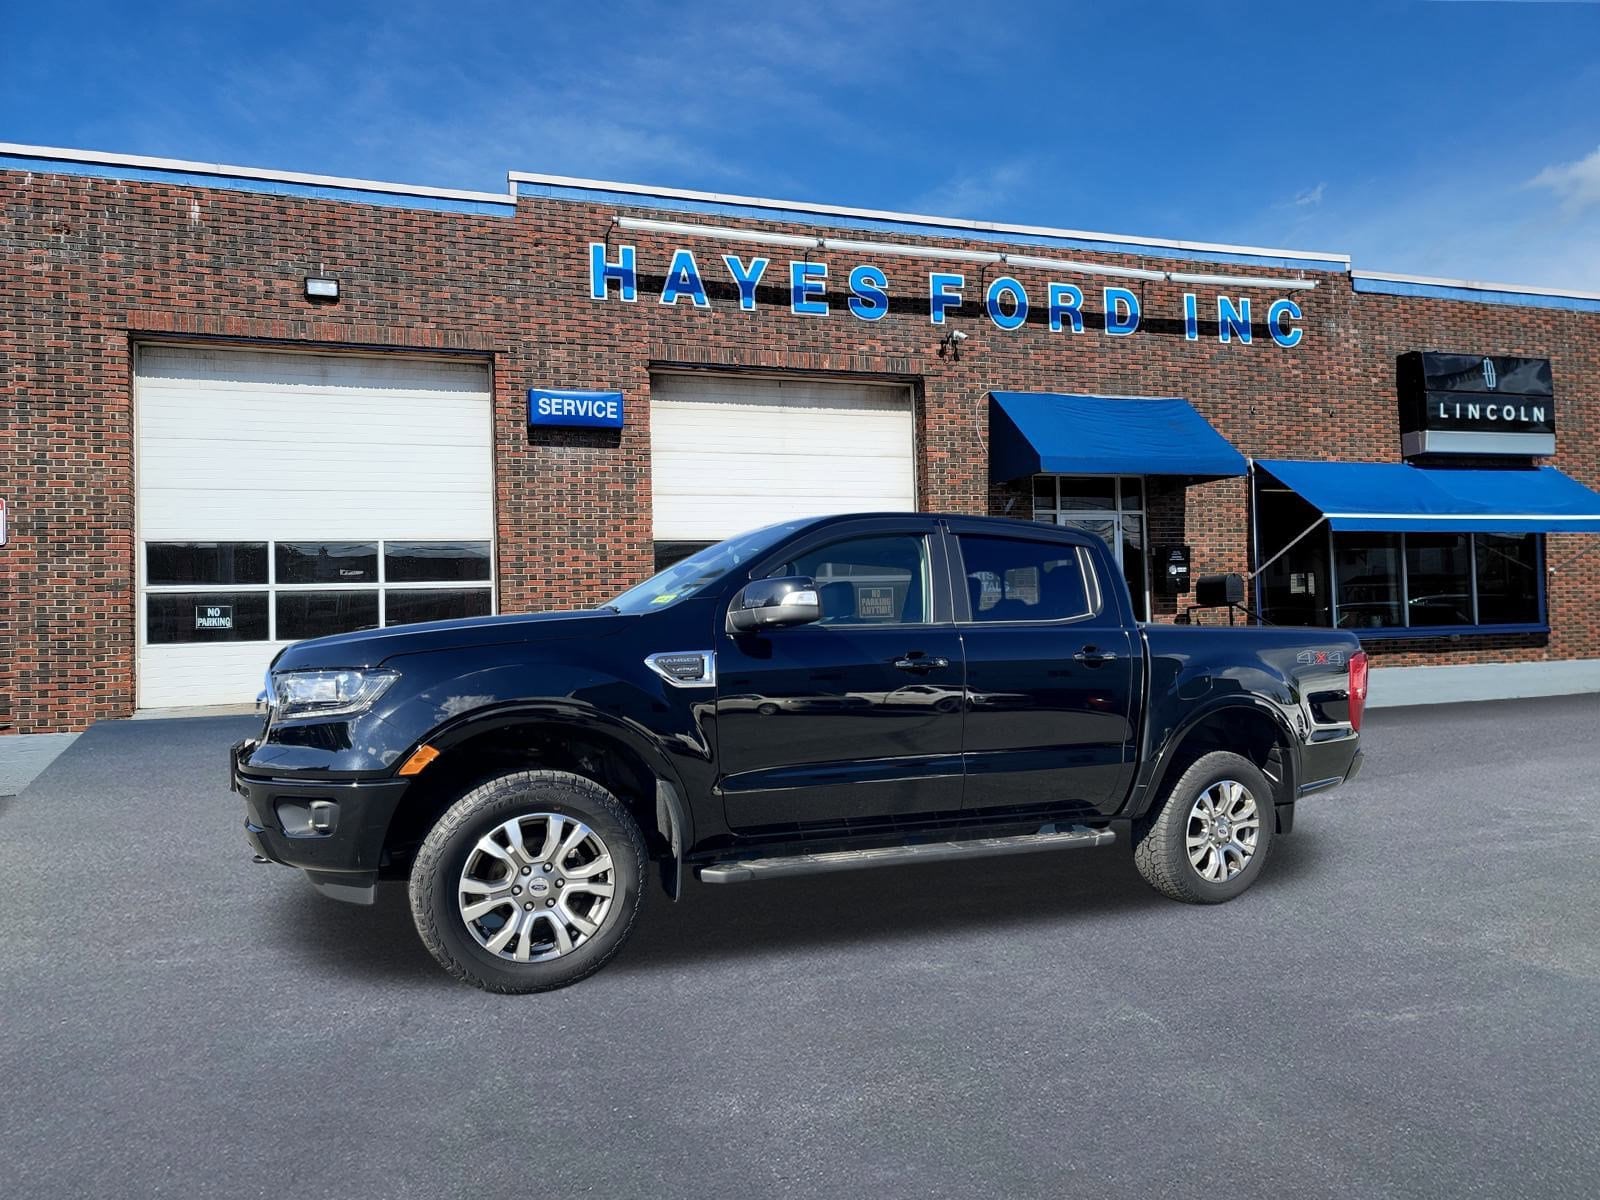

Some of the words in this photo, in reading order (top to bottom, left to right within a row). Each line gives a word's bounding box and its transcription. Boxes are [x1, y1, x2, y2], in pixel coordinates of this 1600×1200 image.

[589, 242, 889, 321] HAYES
[929, 271, 1140, 337] FORD
[1183, 292, 1304, 348] INC
[538, 397, 618, 419] SERVICE
[1439, 402, 1545, 422] LINCOLN
[861, 597, 892, 606] PARKING
[207, 608, 221, 617] NO
[197, 617, 231, 627] PARKING
